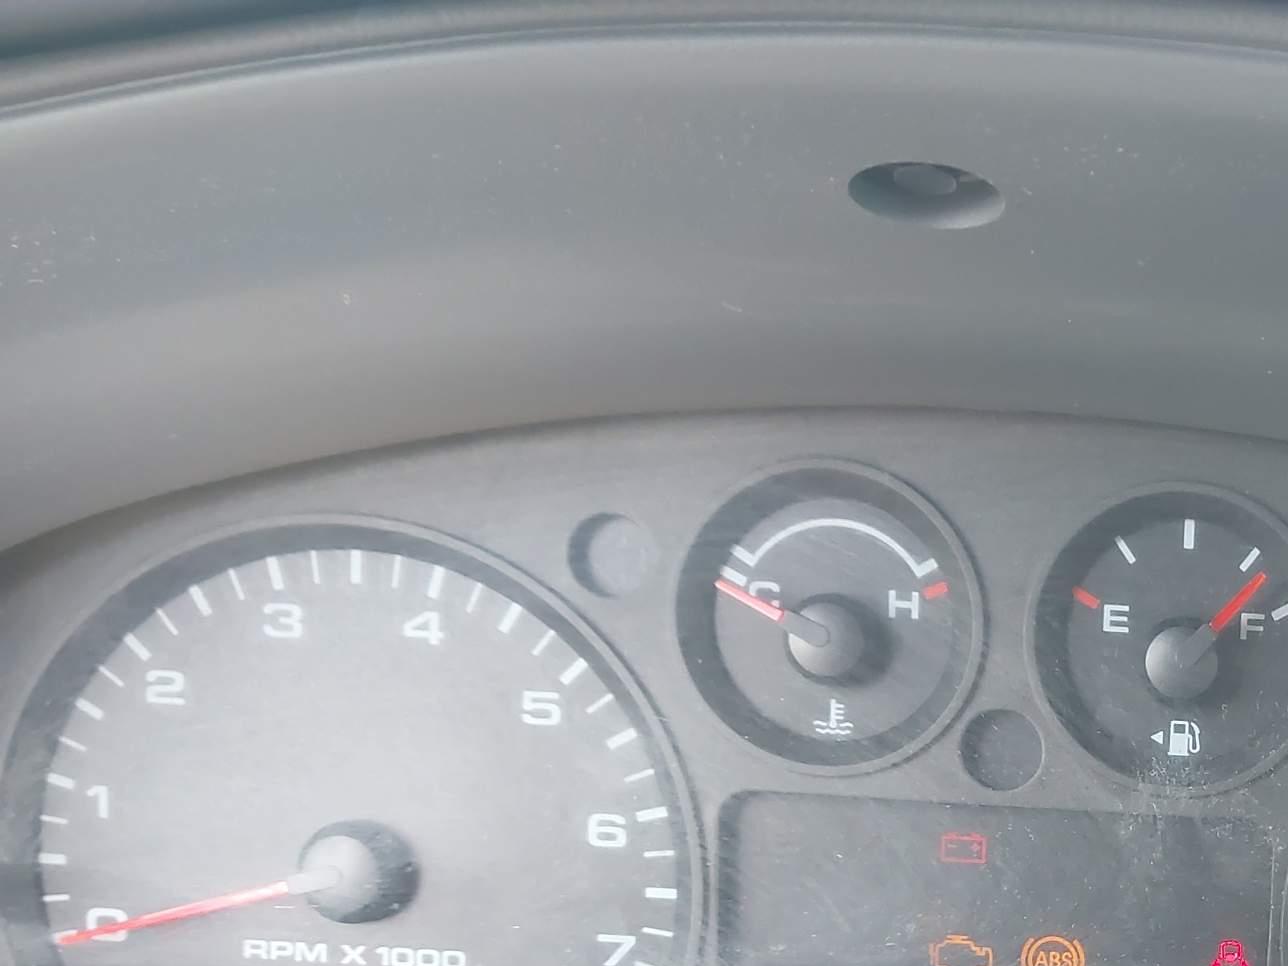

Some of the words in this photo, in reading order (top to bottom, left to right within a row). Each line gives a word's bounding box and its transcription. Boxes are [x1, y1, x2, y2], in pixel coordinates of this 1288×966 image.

[263, 602, 304, 638] 3
[888, 590, 919, 620] H
[1102, 603, 1130, 633] E
[403, 611, 444, 645] 4
[1239, 612, 1265, 640] F
[145, 670, 185, 705] 2
[521, 690, 562, 726] 5
[87, 785, 109, 819] 1
[586, 813, 627, 848] 6
[85, 908, 129, 942] 0
[242, 939, 328, 964] RPM
[340, 944, 367, 966] X
